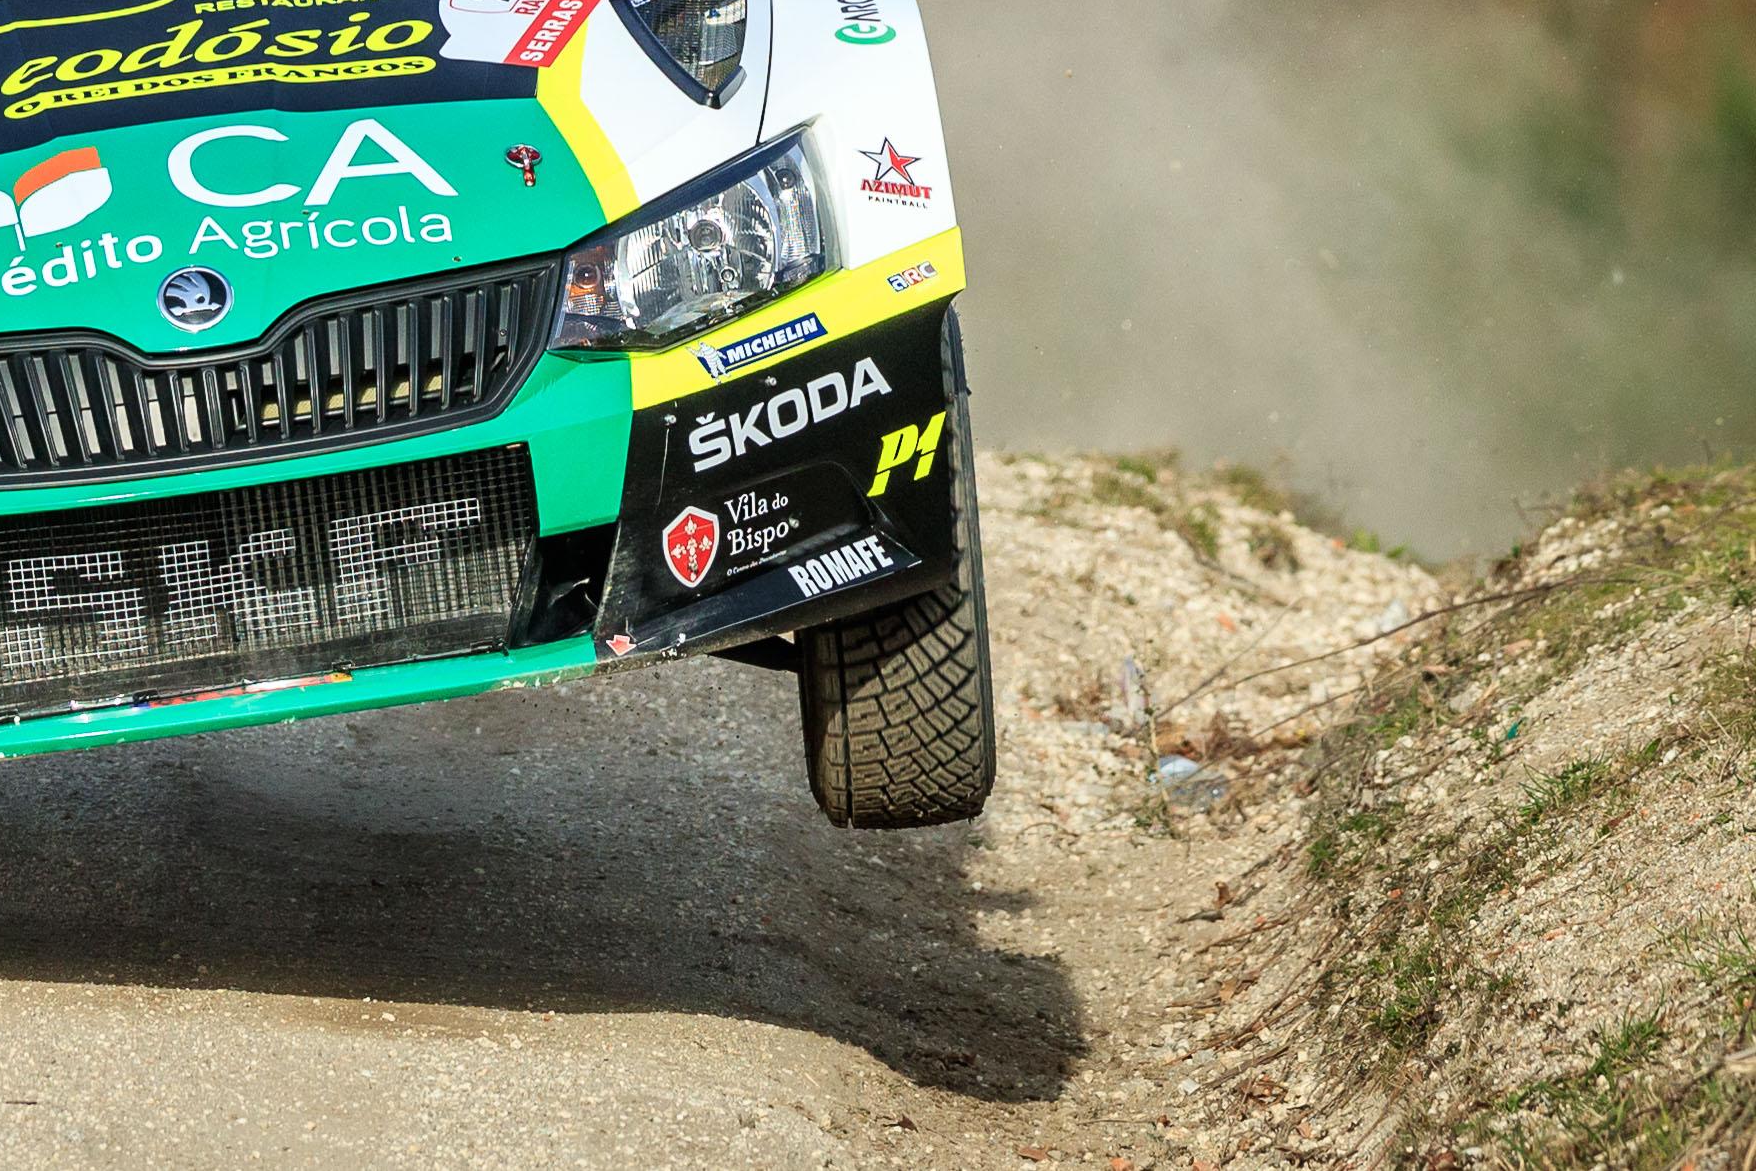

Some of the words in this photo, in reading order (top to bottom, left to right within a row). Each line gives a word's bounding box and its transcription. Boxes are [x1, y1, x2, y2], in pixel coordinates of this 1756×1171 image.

[520, 0, 581, 63] SERRAS
[15, 101, 40, 114] O
[52, 86, 120, 103] REI
[132, 74, 214, 93] DOS
[228, 59, 426, 80] FRANGOS
[166, 117, 459, 209] CA
[860, 178, 932, 200] AZIMUT
[868, 195, 928, 209] PAINTBALL
[188, 205, 453, 259] Agrícola
[727, 317, 820, 364] MICHELIN
[689, 356, 892, 473] ŠKODA
[867, 411, 947, 497] P1
[724, 491, 769, 524] Vila
[772, 492, 789, 510] do
[727, 521, 790, 556] Bispo
[788, 534, 894, 598] ROMAFE
